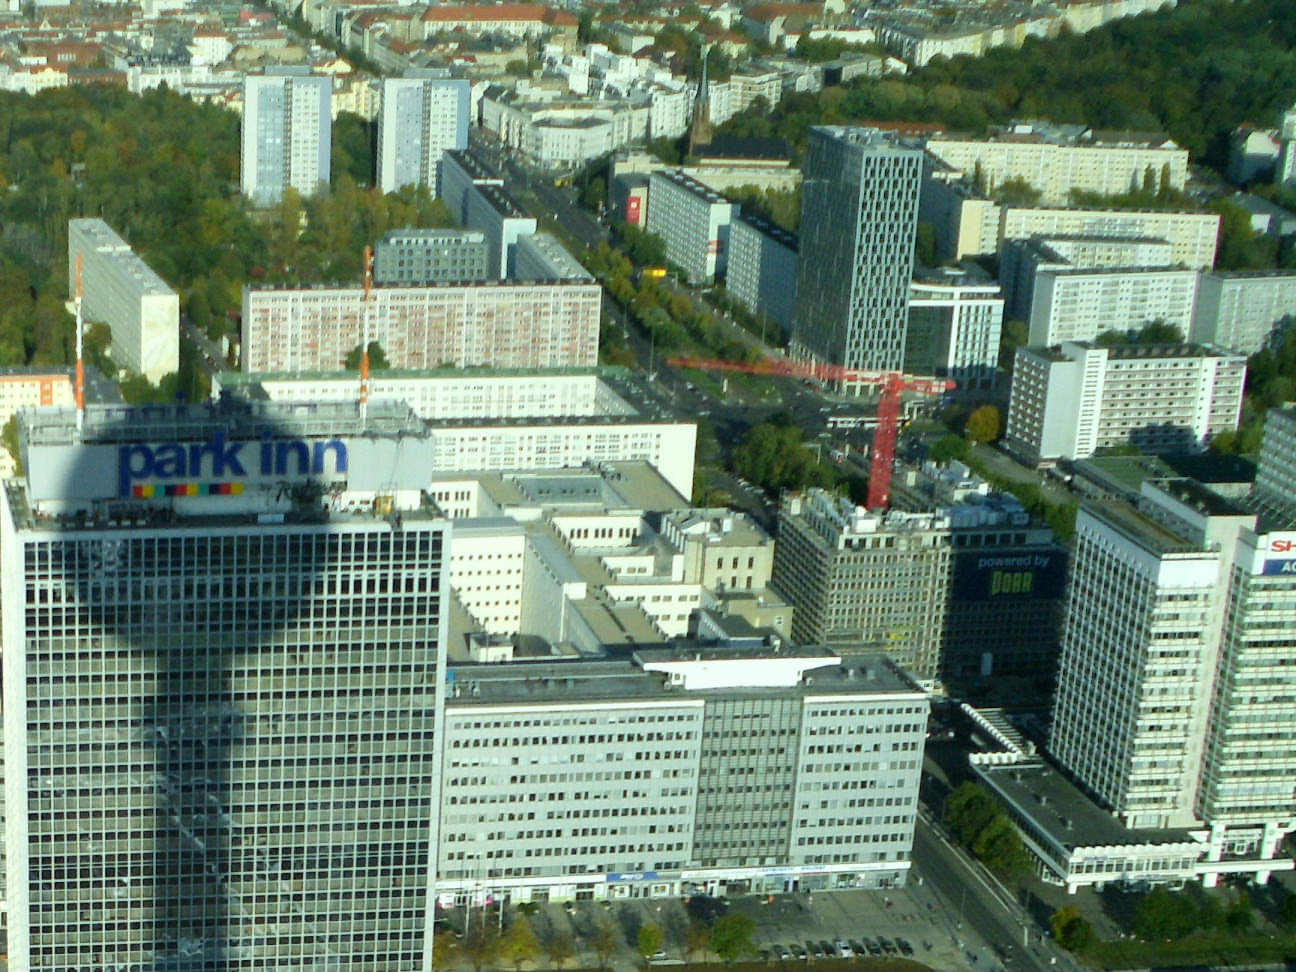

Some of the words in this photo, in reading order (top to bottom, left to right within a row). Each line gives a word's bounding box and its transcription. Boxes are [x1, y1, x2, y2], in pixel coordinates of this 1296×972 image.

[119, 432, 247, 496] park
[260, 432, 348, 475] inn
[978, 555, 1032, 570] powered
[1034, 552, 1050, 568] by
